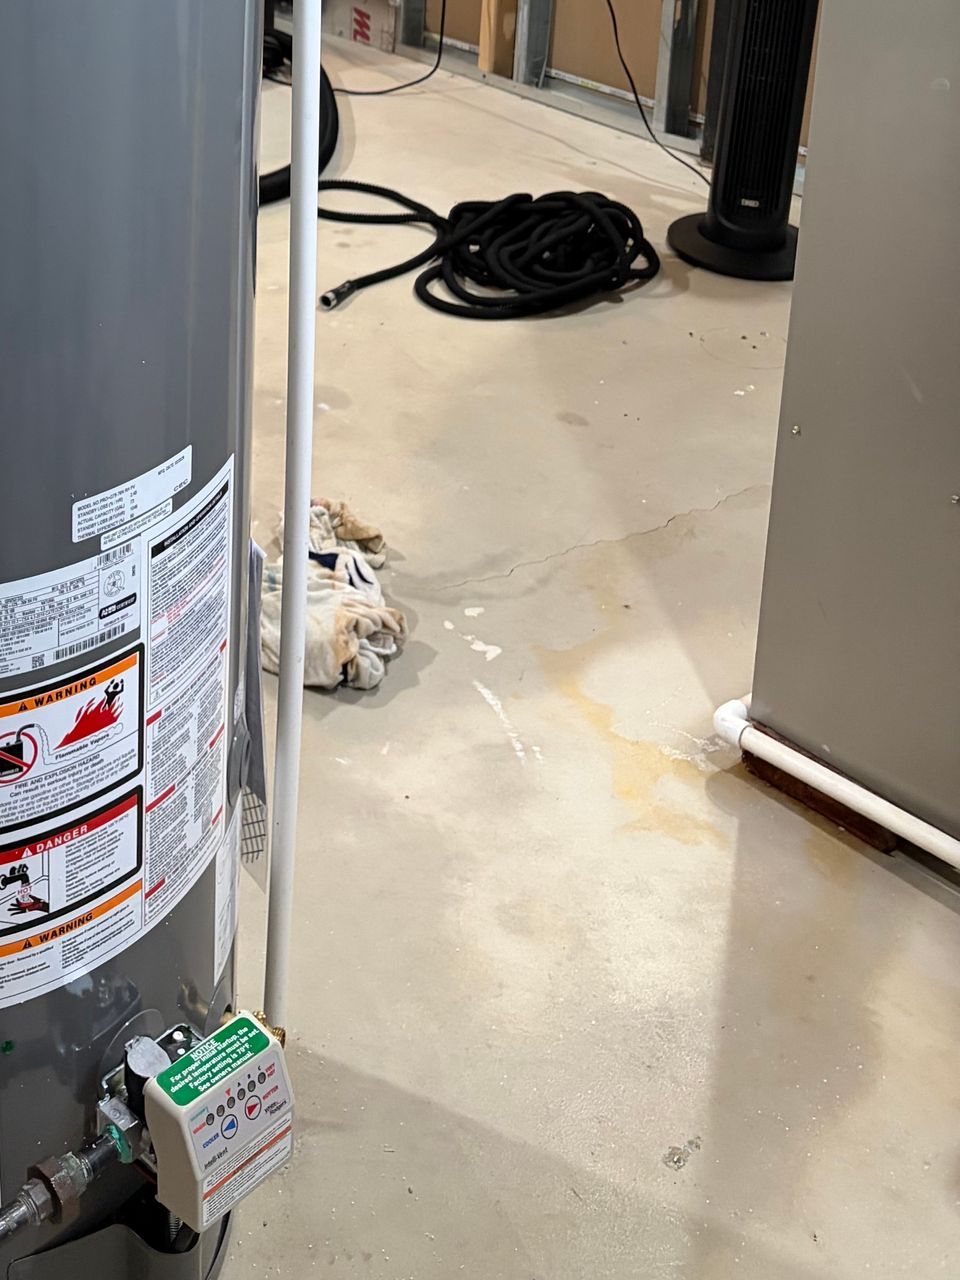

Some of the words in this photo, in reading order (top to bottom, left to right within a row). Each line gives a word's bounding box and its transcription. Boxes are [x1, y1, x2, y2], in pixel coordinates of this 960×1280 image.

[34, 677, 97, 708] WARNING
[55, 743, 89, 760] Flammable
[14, 782, 28, 790] FIRE
[44, 764, 77, 780] EXPLOSION
[78, 754, 100, 768] HAZARD
[23, 786, 38, 794] result
[47, 775, 67, 786] serious
[68, 769, 83, 779] injury
[90, 758, 104, 768] death
[36, 824, 88, 852] DANGER
[17, 886, 33, 896] HOT
[39, 913, 94, 943] WARNING
[170, 1074, 182, 1083] For
[182, 1061, 201, 1077] proper
[200, 1048, 217, 1061] initial
[217, 1035, 239, 1051] startup,
[237, 1027, 248, 1036] the
[190, 1039, 218, 1060] NOTICE
[171, 1075, 192, 1092] desired
[192, 1052, 226, 1077] temperature
[226, 1041, 241, 1054] must
[188, 1071, 212, 1089] Factory
[212, 1057, 232, 1073] setting
[198, 1082, 210, 1092] See
[210, 1067, 232, 1083] owners
